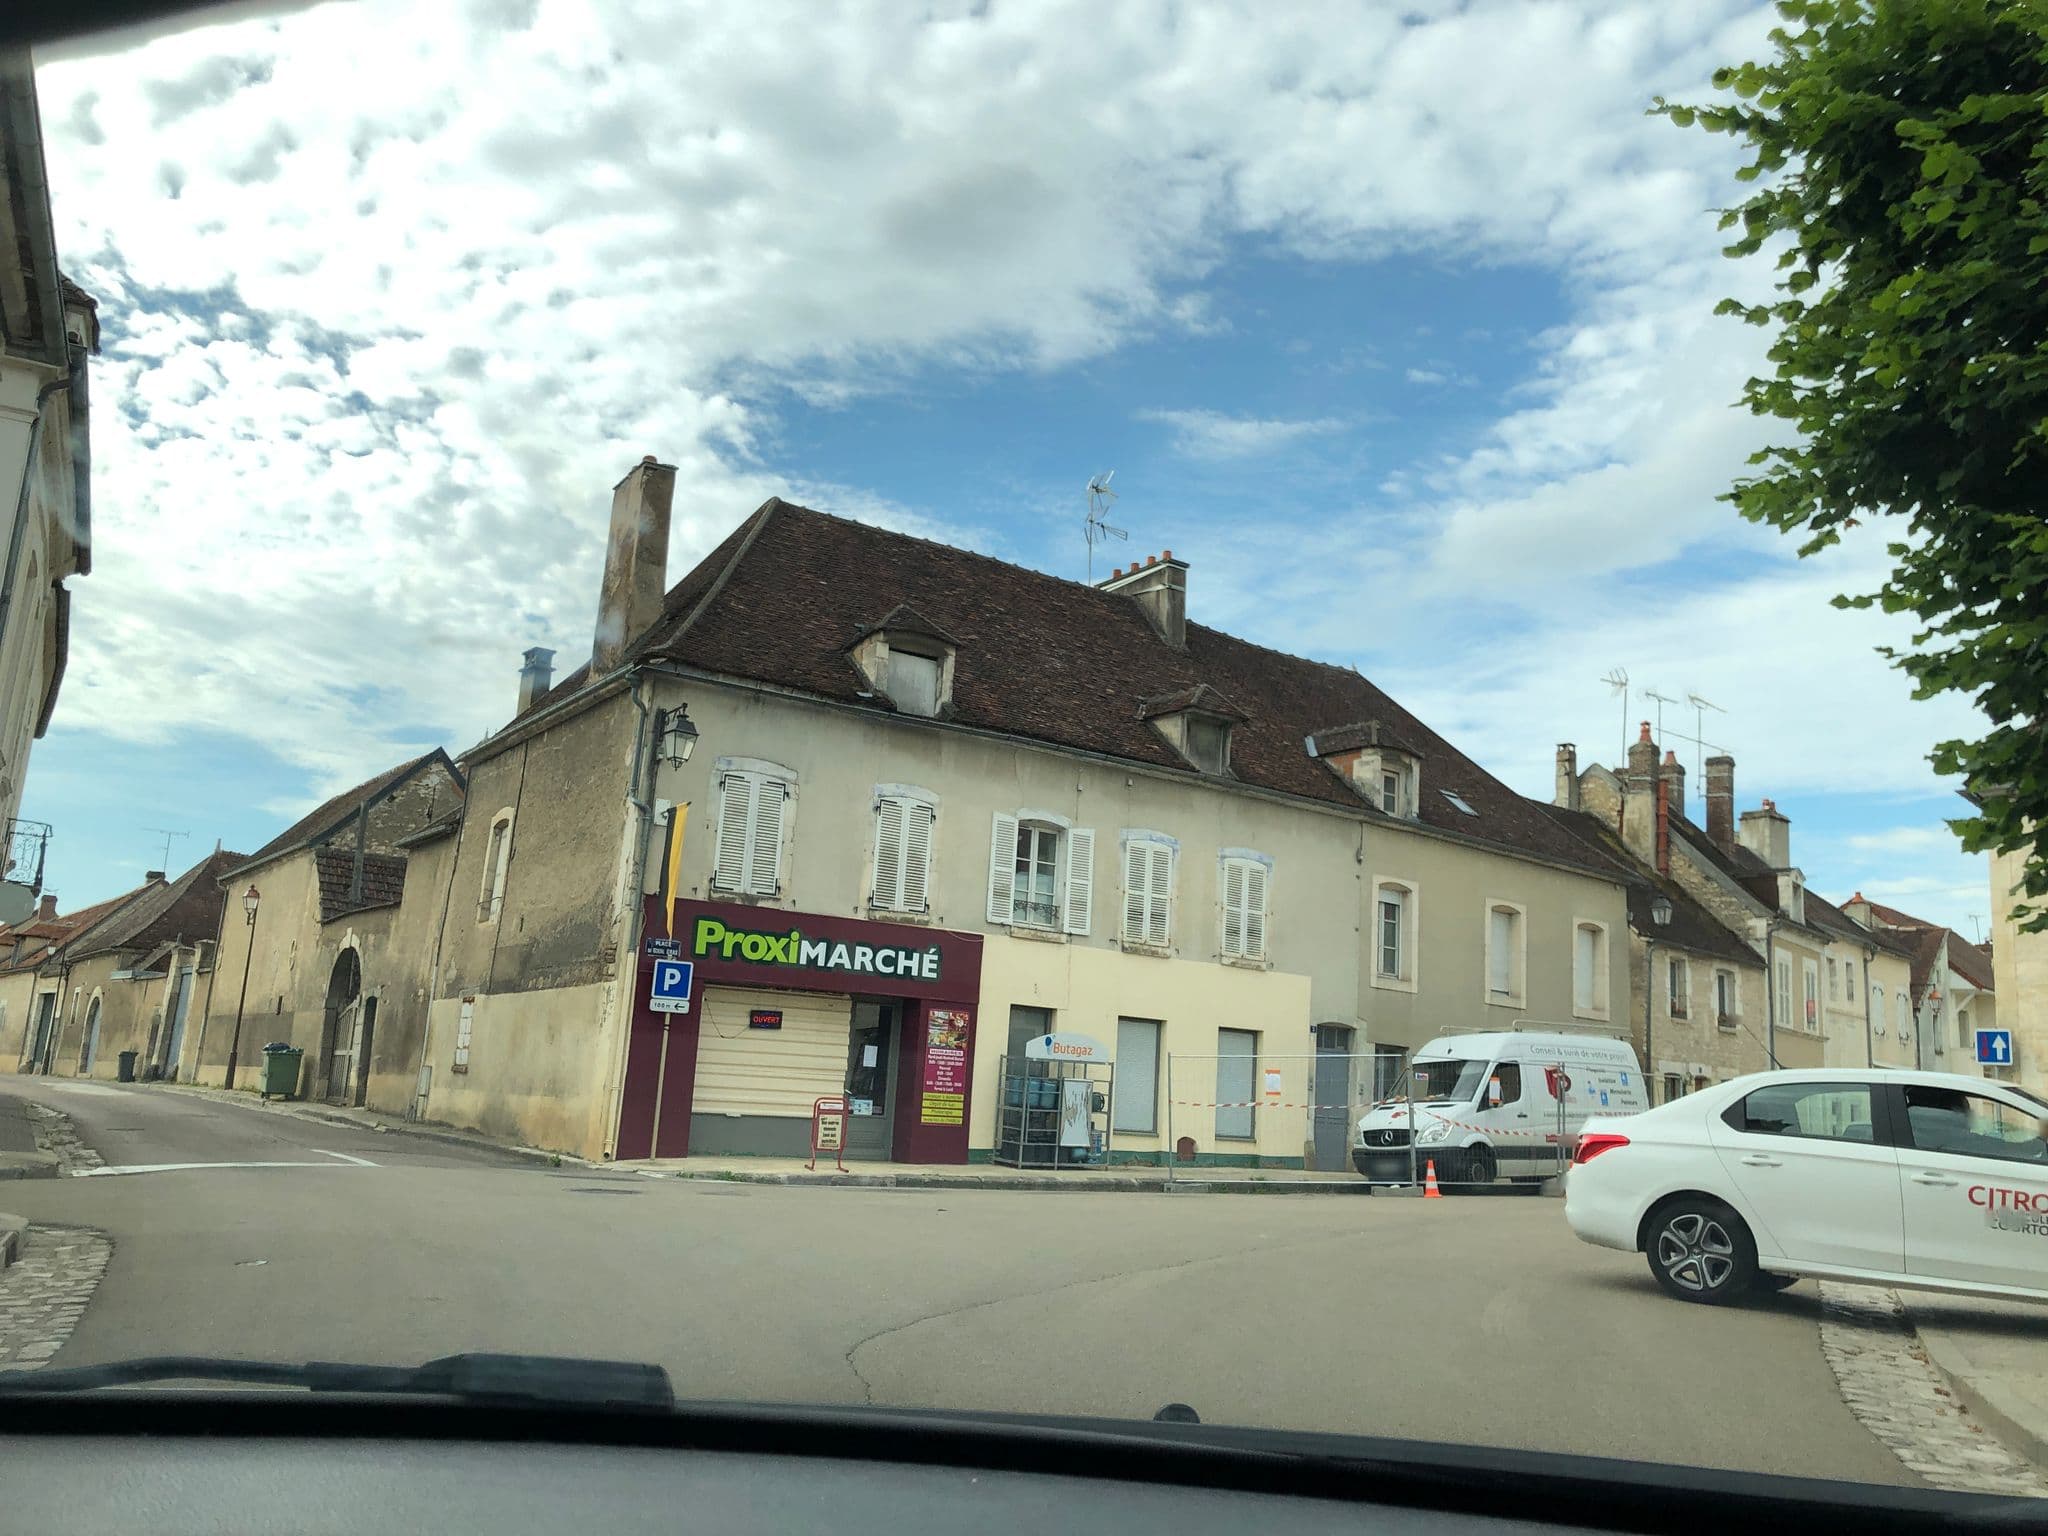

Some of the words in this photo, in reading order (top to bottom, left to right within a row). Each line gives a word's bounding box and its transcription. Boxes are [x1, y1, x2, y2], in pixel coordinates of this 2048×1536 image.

[663, 968, 681, 991] P
[753, 1015, 780, 1024] OUVERT
[1053, 1043, 1093, 1057] Butagaz
